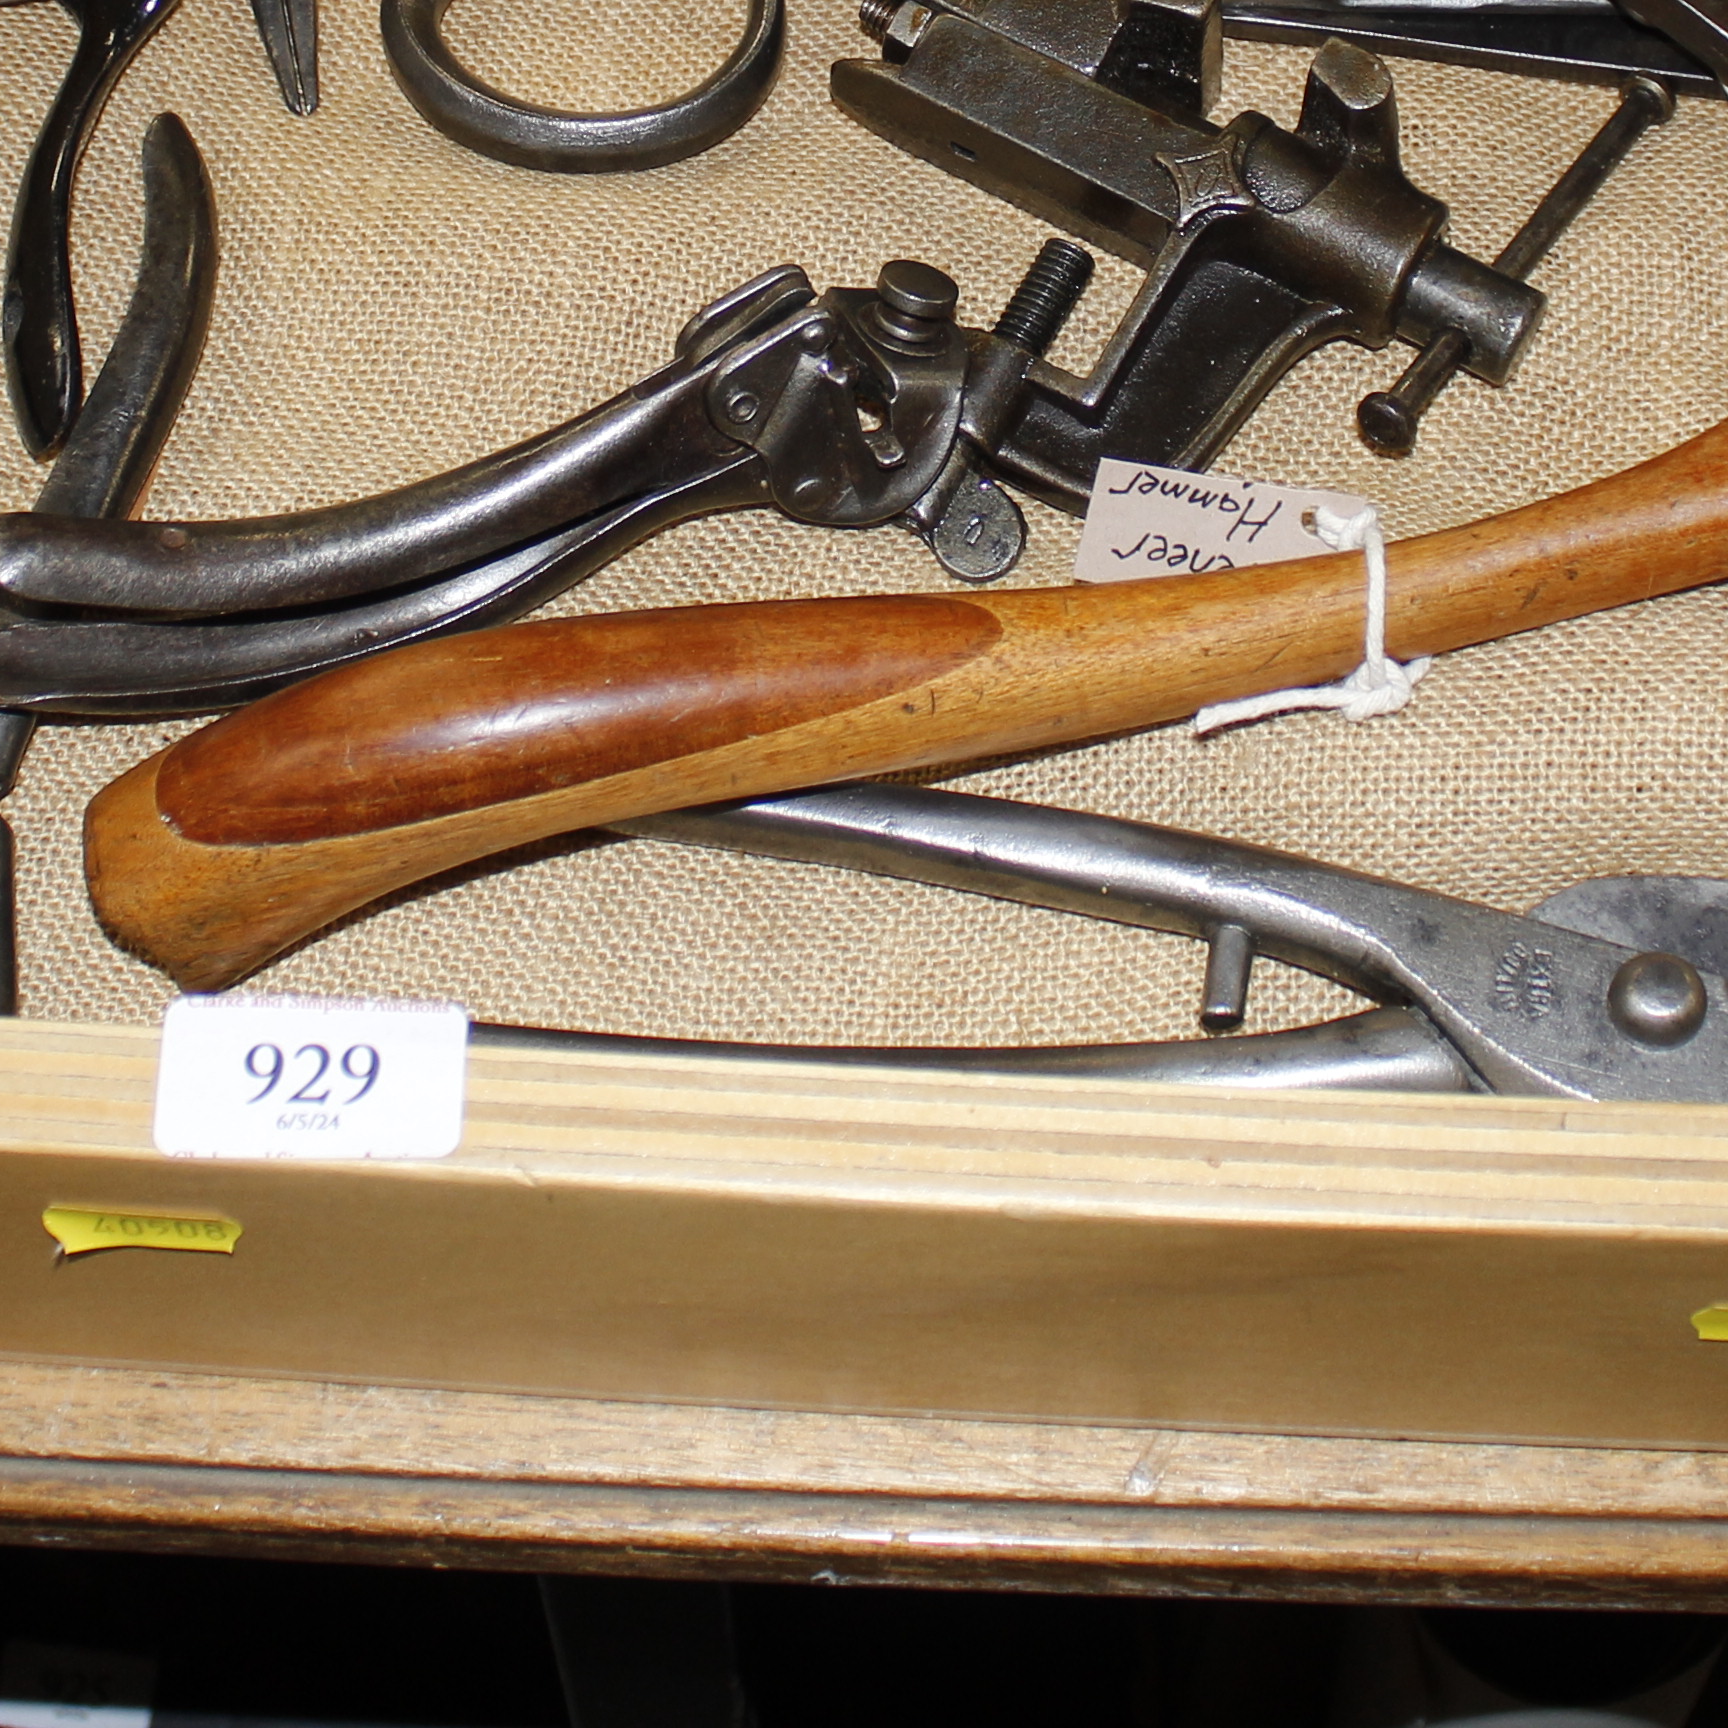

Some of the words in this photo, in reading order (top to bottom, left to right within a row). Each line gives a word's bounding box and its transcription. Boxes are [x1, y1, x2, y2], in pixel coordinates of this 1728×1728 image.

[1108, 470, 1282, 543] Hammer
[1111, 533, 1235, 573] eneer
[187, 995, 246, 1009] Clarke
[251, 995, 282, 1009] and
[290, 996, 365, 1015] Simpson
[367, 998, 452, 1014] Auctions
[244, 1042, 381, 1106] 929
[275, 1113, 341, 1131] 6/5/24
